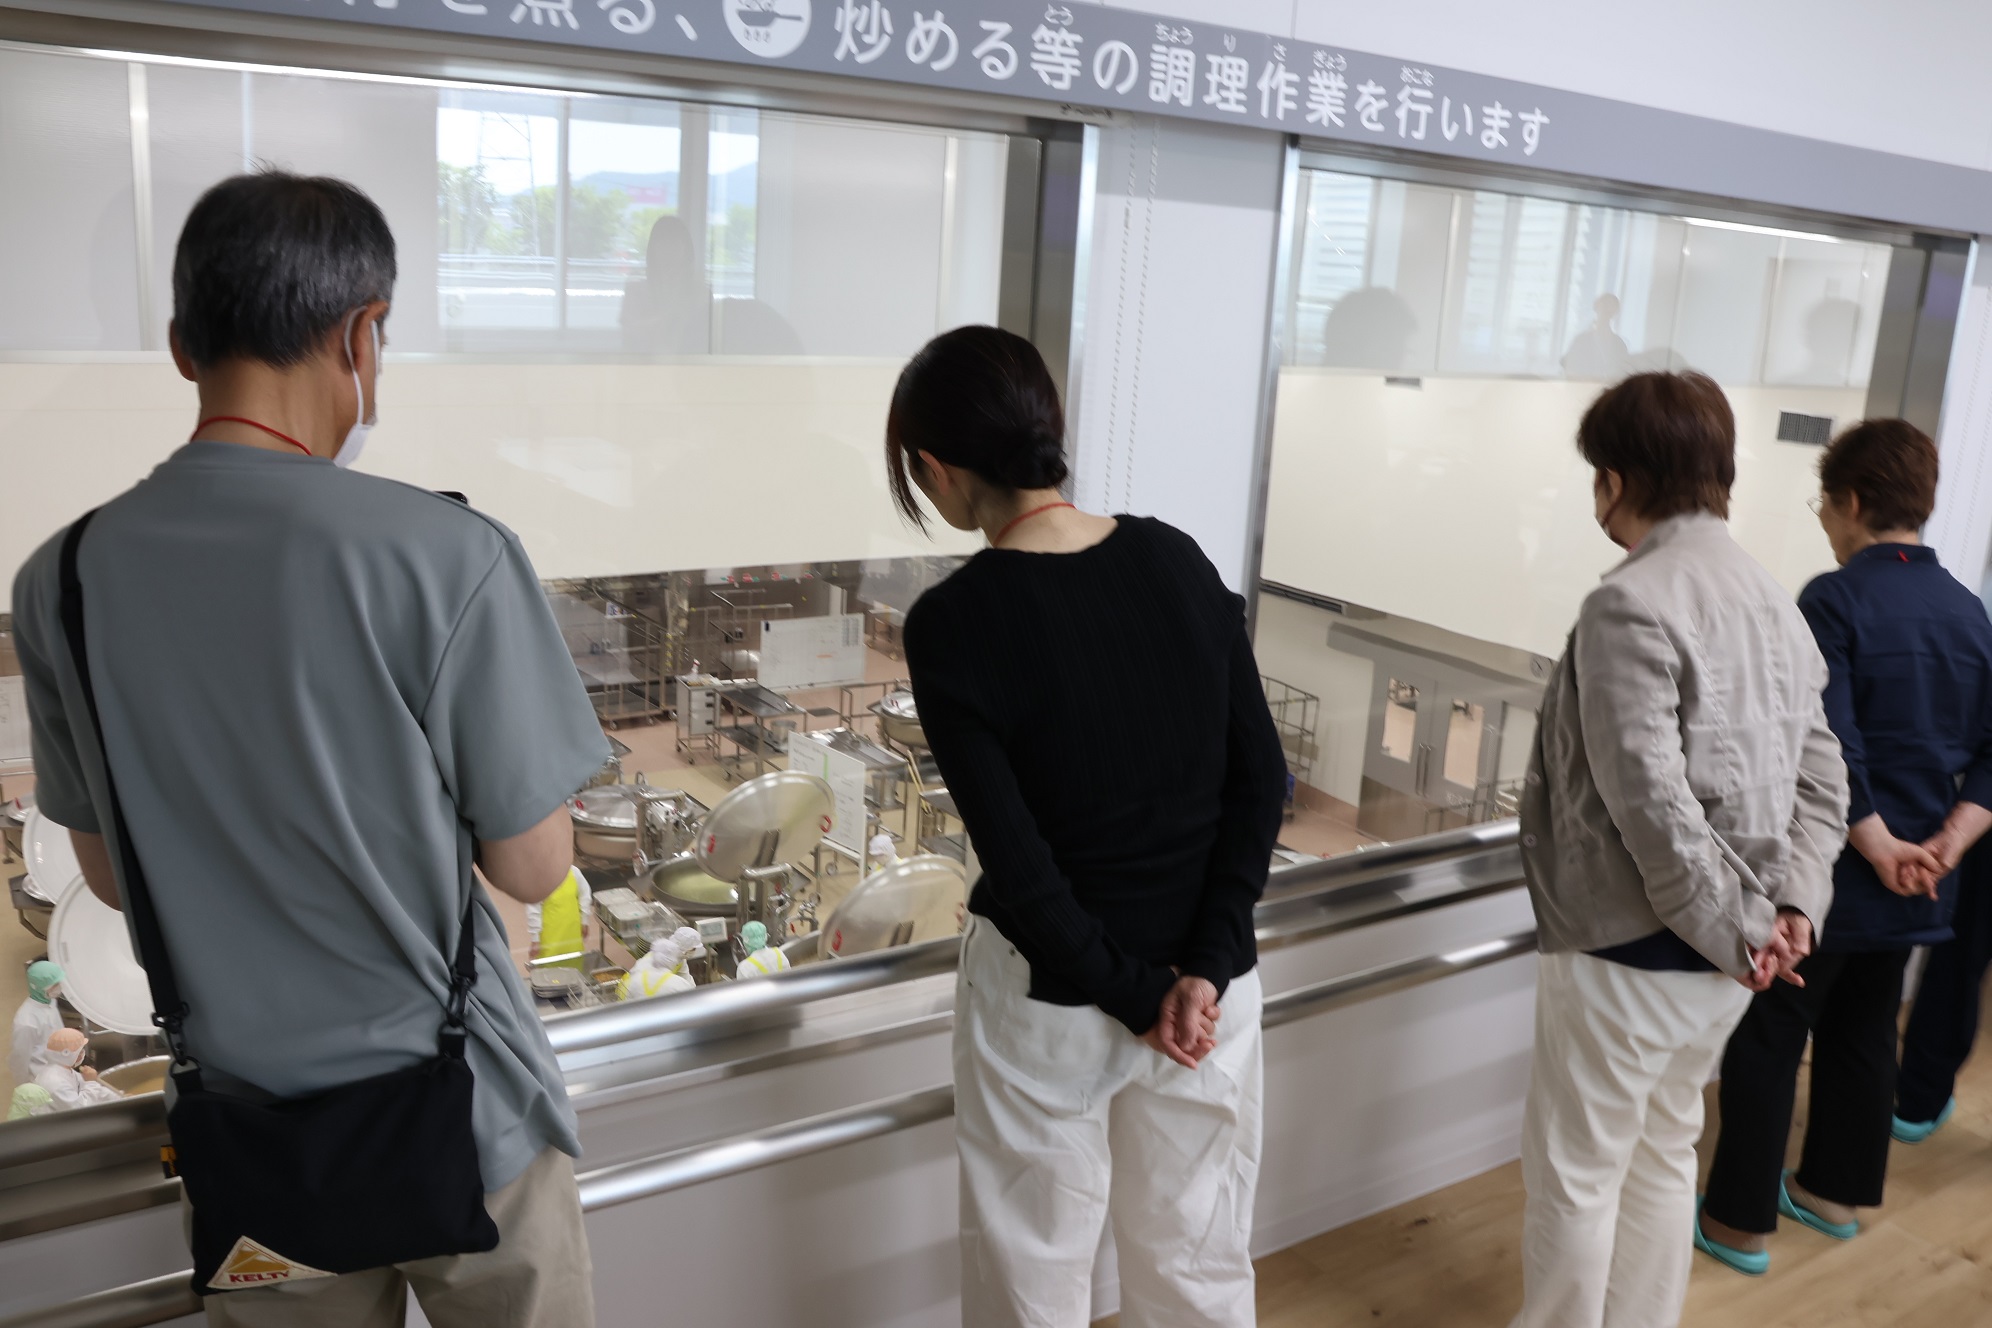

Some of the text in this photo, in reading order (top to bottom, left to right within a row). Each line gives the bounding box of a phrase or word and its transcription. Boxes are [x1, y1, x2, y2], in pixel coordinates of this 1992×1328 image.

[834, 0, 1550, 156] 炒める等の調理作業を行います
[229, 1271, 289, 1283] KELTY
